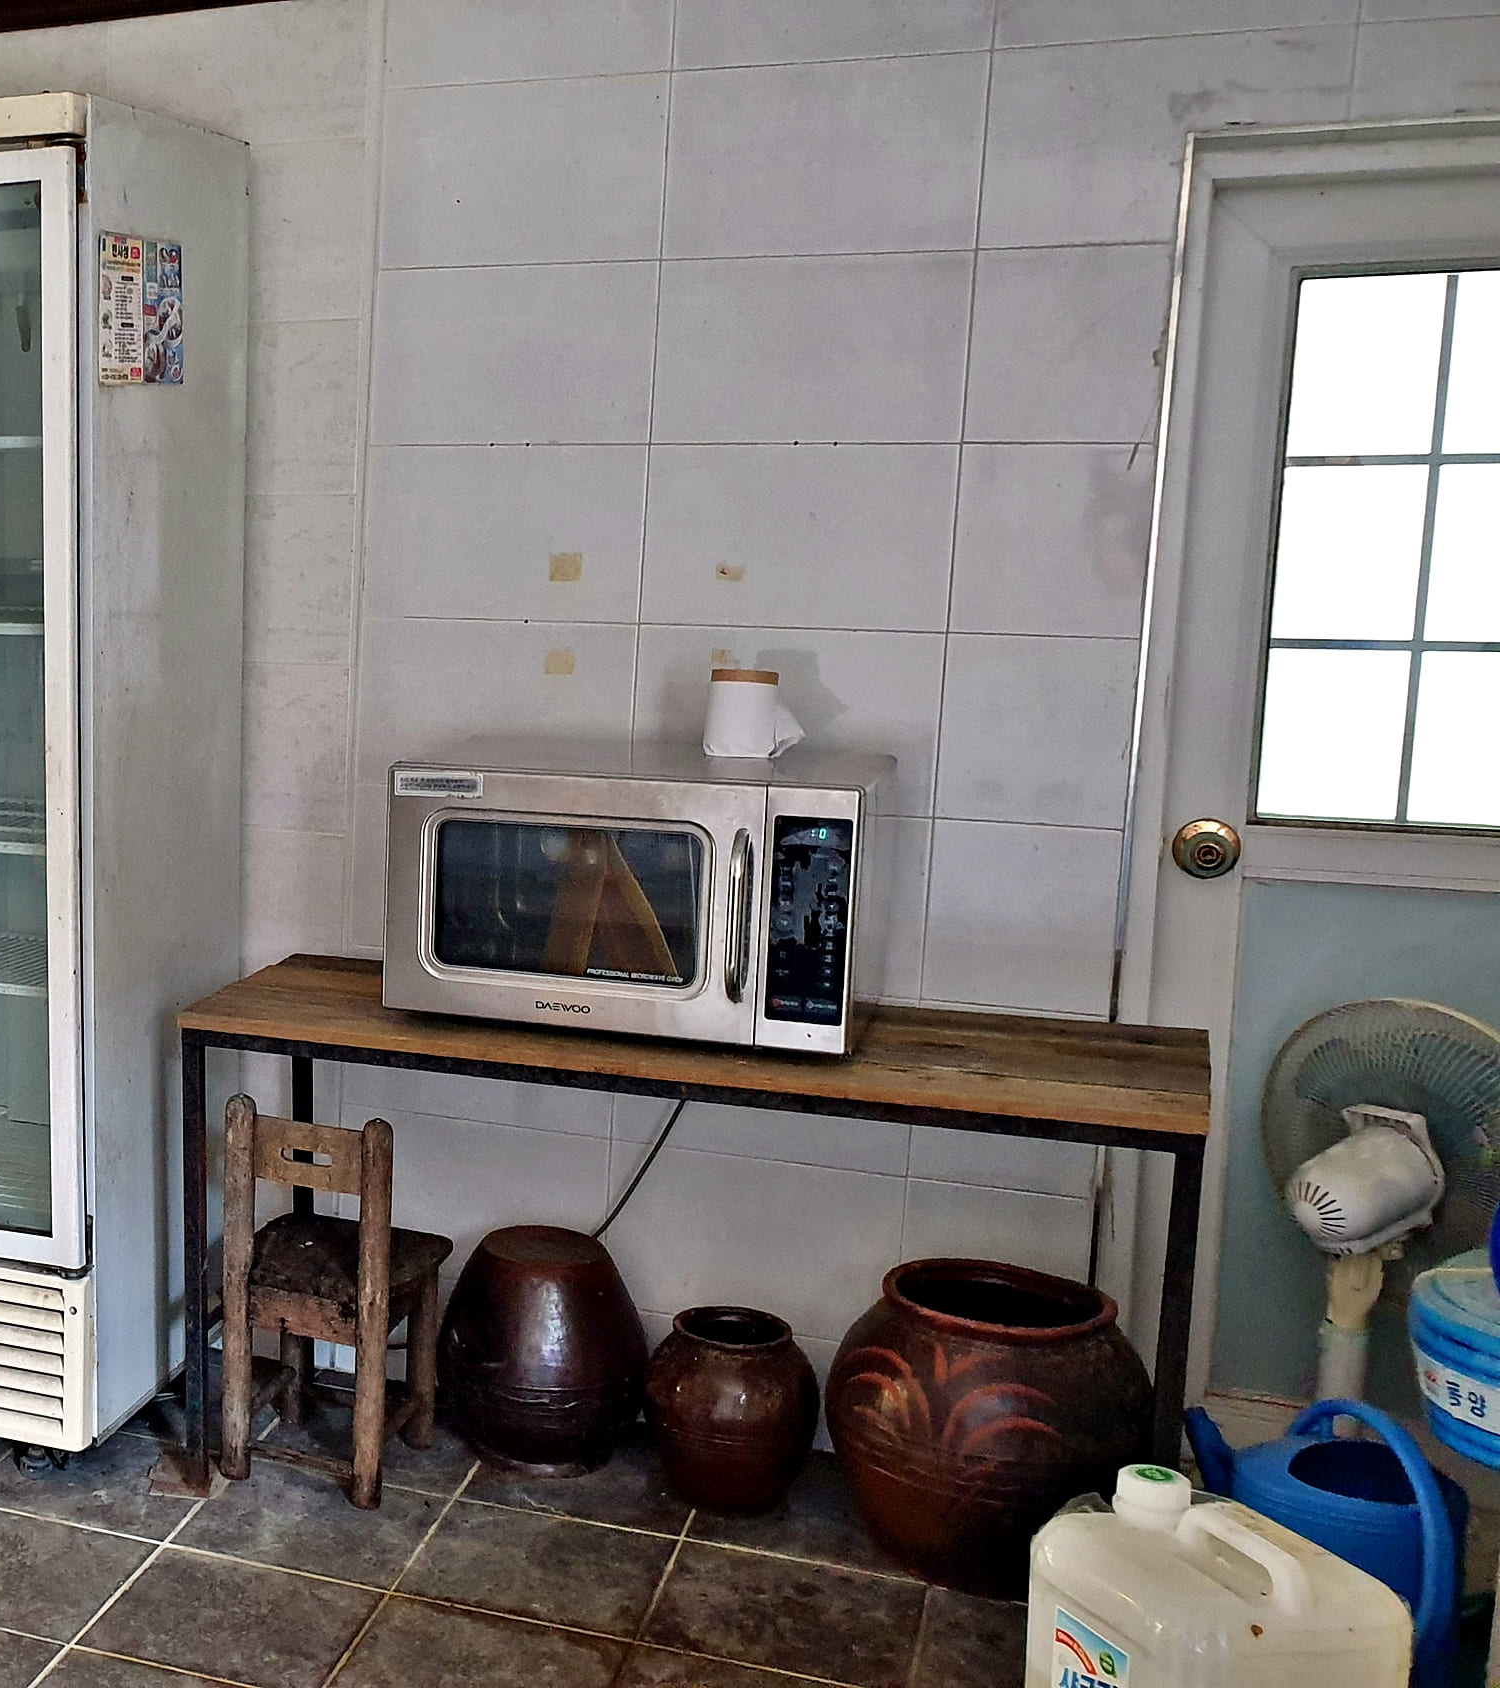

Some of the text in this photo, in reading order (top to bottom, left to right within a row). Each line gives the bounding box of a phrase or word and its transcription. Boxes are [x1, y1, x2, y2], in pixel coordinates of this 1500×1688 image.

[587, 968, 629, 977] PROFESSIONAL
[631, 973, 665, 981] MICROWAVE
[536, 1001, 590, 1013] DAEWOO
